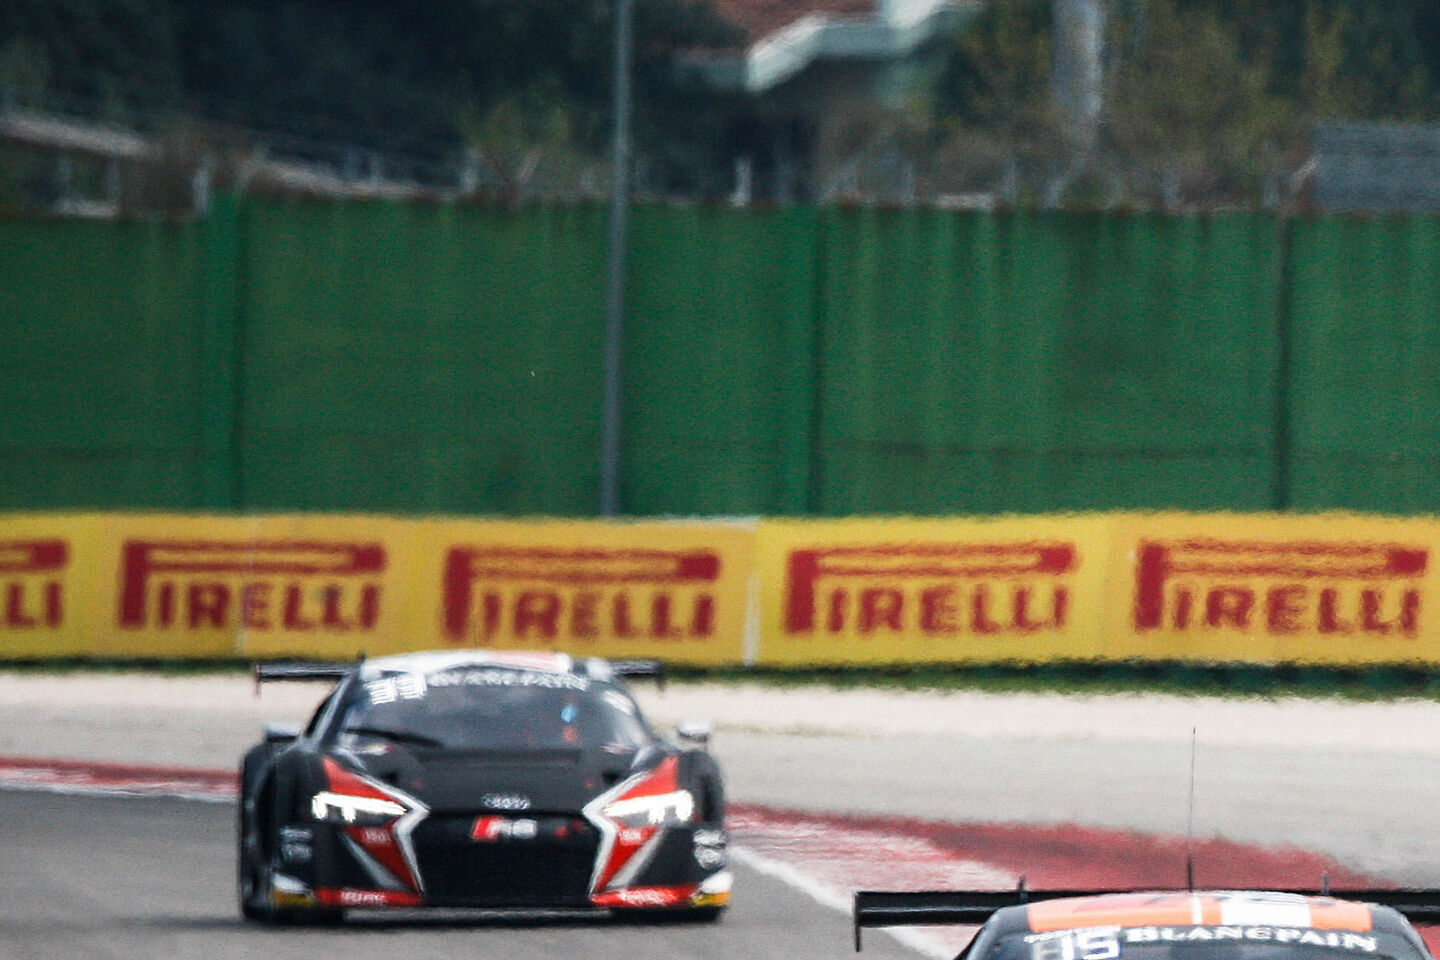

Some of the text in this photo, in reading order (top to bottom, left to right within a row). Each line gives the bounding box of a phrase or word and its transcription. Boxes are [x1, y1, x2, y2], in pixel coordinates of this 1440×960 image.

[118, 541, 386, 630] PIRELLI
[441, 546, 721, 641] PIRELLI
[784, 541, 1078, 636] PIRELLI
[1134, 537, 1428, 637] PIRELLI
[1127, 926, 1377, 952] BLANCPAIN
